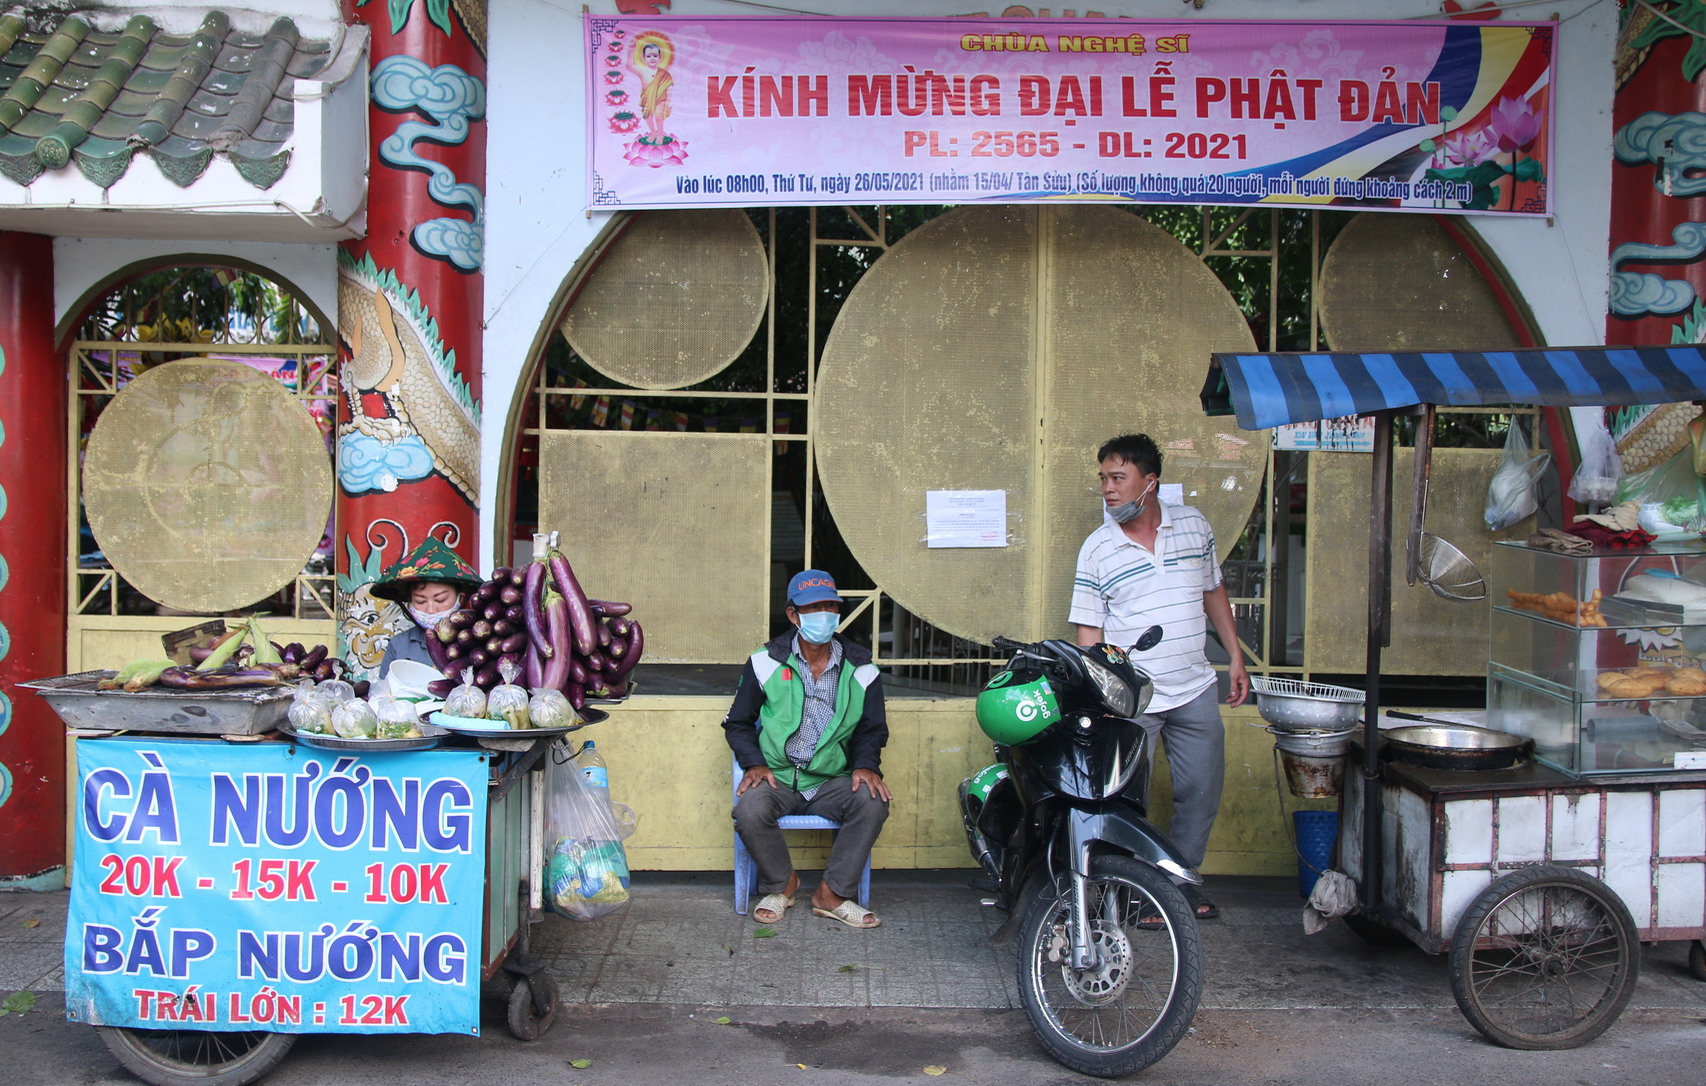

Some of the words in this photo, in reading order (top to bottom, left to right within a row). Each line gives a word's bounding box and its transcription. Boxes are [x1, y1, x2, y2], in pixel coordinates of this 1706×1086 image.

[960, 32, 1050, 52] CHÙA
[1058, 34, 1146, 55] NGHỆ
[1156, 34, 1191, 53] SĨ
[706, 66, 831, 119] KÍNH
[847, 64, 1001, 118] MỪNG
[1017, 75, 1103, 127] ĐẠI
[1121, 61, 1177, 118] LỄ
[1195, 69, 1322, 130] PHẬT
[1337, 67, 1440, 126] ĐẢN
[904, 131, 958, 158] PL:
[970, 131, 1059, 158] 2565
[1098, 132, 1152, 159] DL:
[1164, 133, 1247, 160] 2021
[676, 175, 699, 194] Vào
[703, 175, 722, 193] lúc
[726, 175, 768, 195] 08h00,
[772, 173, 795, 192] Thứ
[798, 173, 817, 194] Tư,
[821, 175, 850, 194] ngày
[854, 172, 924, 192] 26/05/2021
[930, 169, 969, 193] (nhằm
[974, 172, 1013, 191] 15/04/
[1017, 172, 1038, 191] Tân
[1043, 170, 1072, 193] Sửu)
[1077, 170, 1098, 193] (Số
[1101, 173, 1136, 196] lượng
[1139, 174, 1179, 195] không
[1182, 175, 1205, 195] quá
[1207, 174, 1224, 194] 20
[1226, 174, 1266, 197] người,
[1270, 172, 1293, 196] mỗi
[1296, 175, 1329, 198] người
[1333, 176, 1363, 199] đứng
[1366, 176, 1410, 201] khoảng
[1413, 179, 1443, 200] cách
[1033, 689, 1051, 719] gojek
[84, 751, 180, 844] CÀ
[211, 757, 473, 854] NƯỚNG
[100, 854, 185, 898] 20K
[197, 877, 214, 890] -
[230, 858, 318, 902] 15K
[331, 880, 348, 893] -
[364, 862, 451, 904] 10K
[82, 906, 216, 979] BẮP
[237, 920, 467, 986] NƯỚNG
[133, 986, 217, 1023] TRÁI
[228, 986, 302, 1024] LỚN
[339, 995, 411, 1026] 12K
